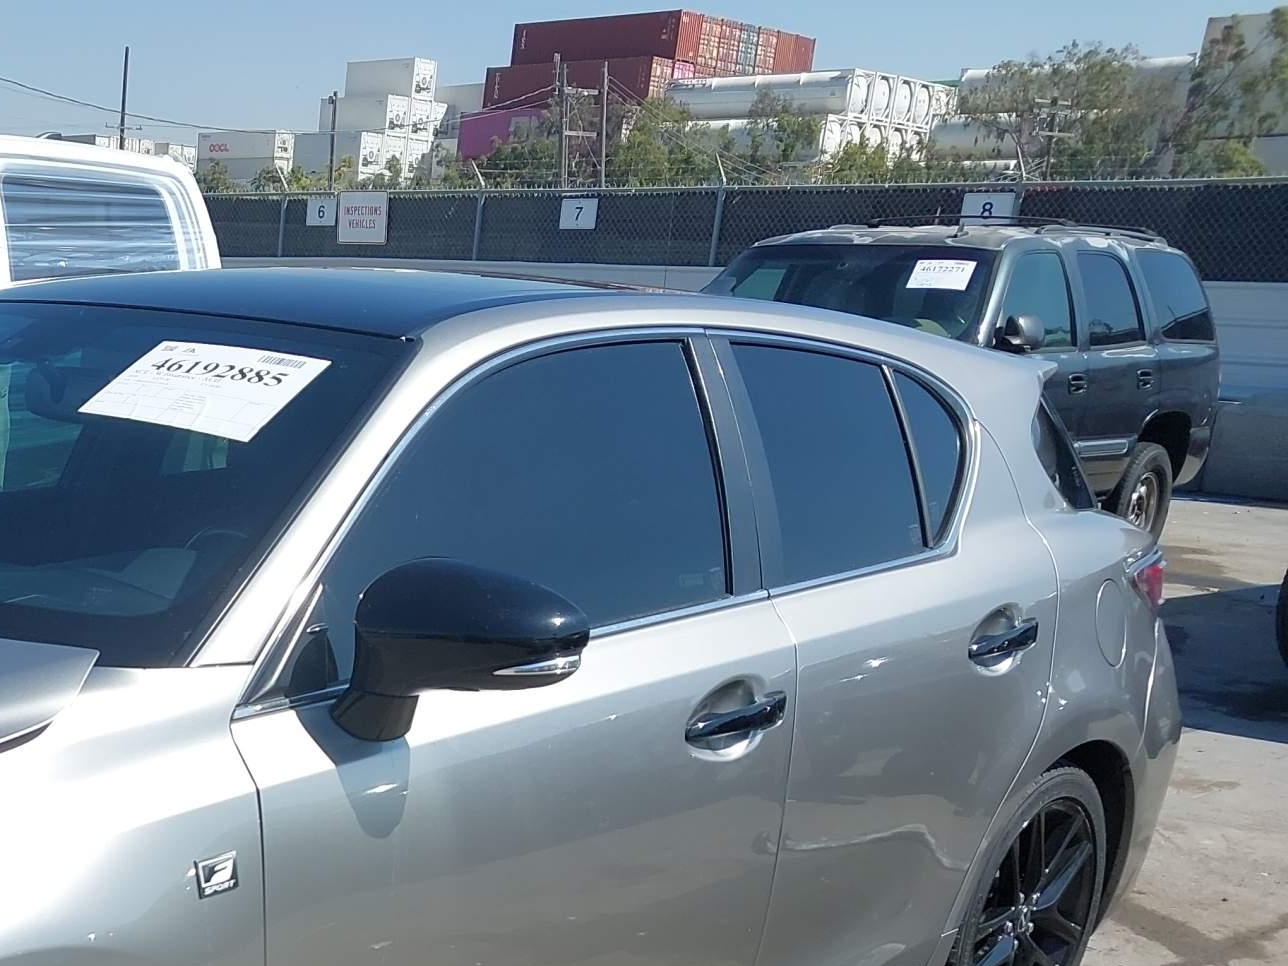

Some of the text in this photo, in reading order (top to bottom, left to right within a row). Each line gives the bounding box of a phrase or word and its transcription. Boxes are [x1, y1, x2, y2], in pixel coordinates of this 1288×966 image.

[209, 143, 230, 153] OOCL
[317, 204, 325, 219] 6
[344, 205, 382, 216] INSPECTIONS
[575, 206, 584, 221] 7
[981, 202, 993, 219] 8
[348, 219, 376, 229] VEHICLES
[151, 357, 289, 387] 46192885
